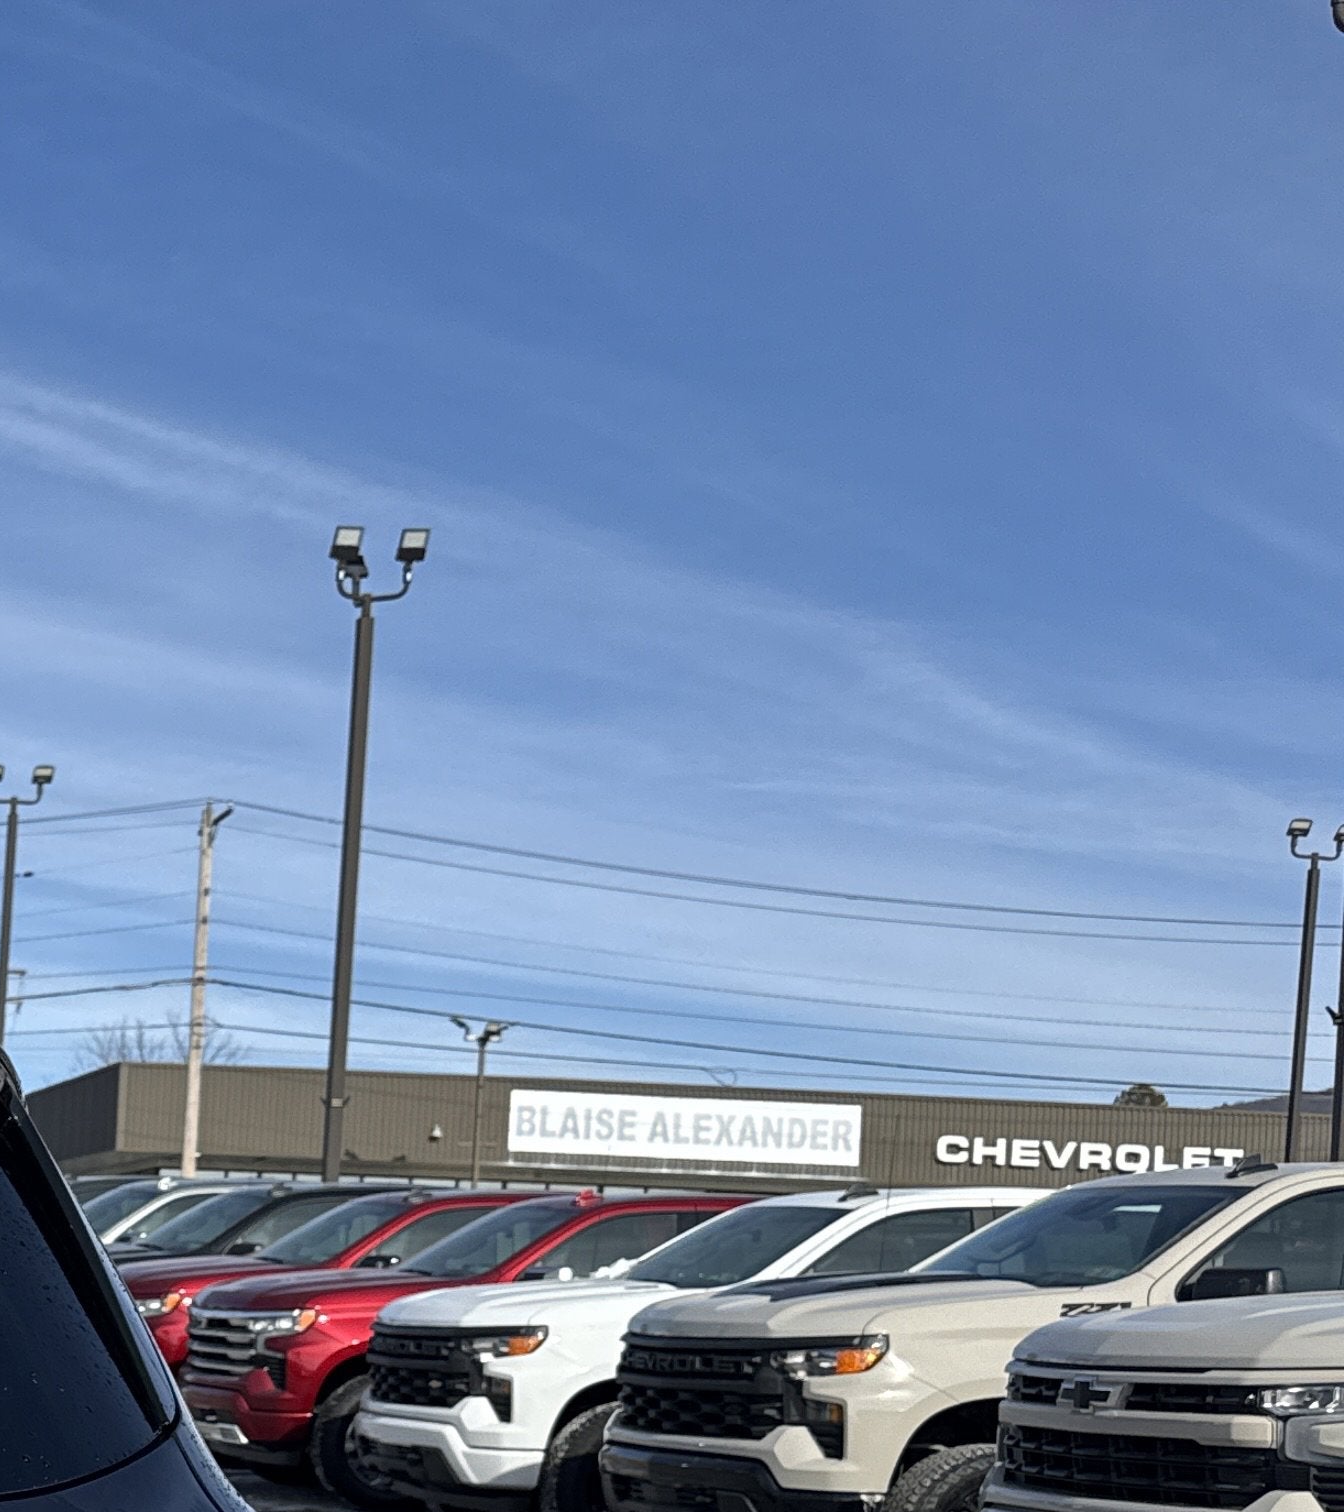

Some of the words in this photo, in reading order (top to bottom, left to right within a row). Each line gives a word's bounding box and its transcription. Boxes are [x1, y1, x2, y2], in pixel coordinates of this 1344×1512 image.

[515, 1104, 638, 1142] BLAISE
[647, 1110, 854, 1153] ALEXANDER
[935, 1134, 1245, 1176] CHEVROLET
